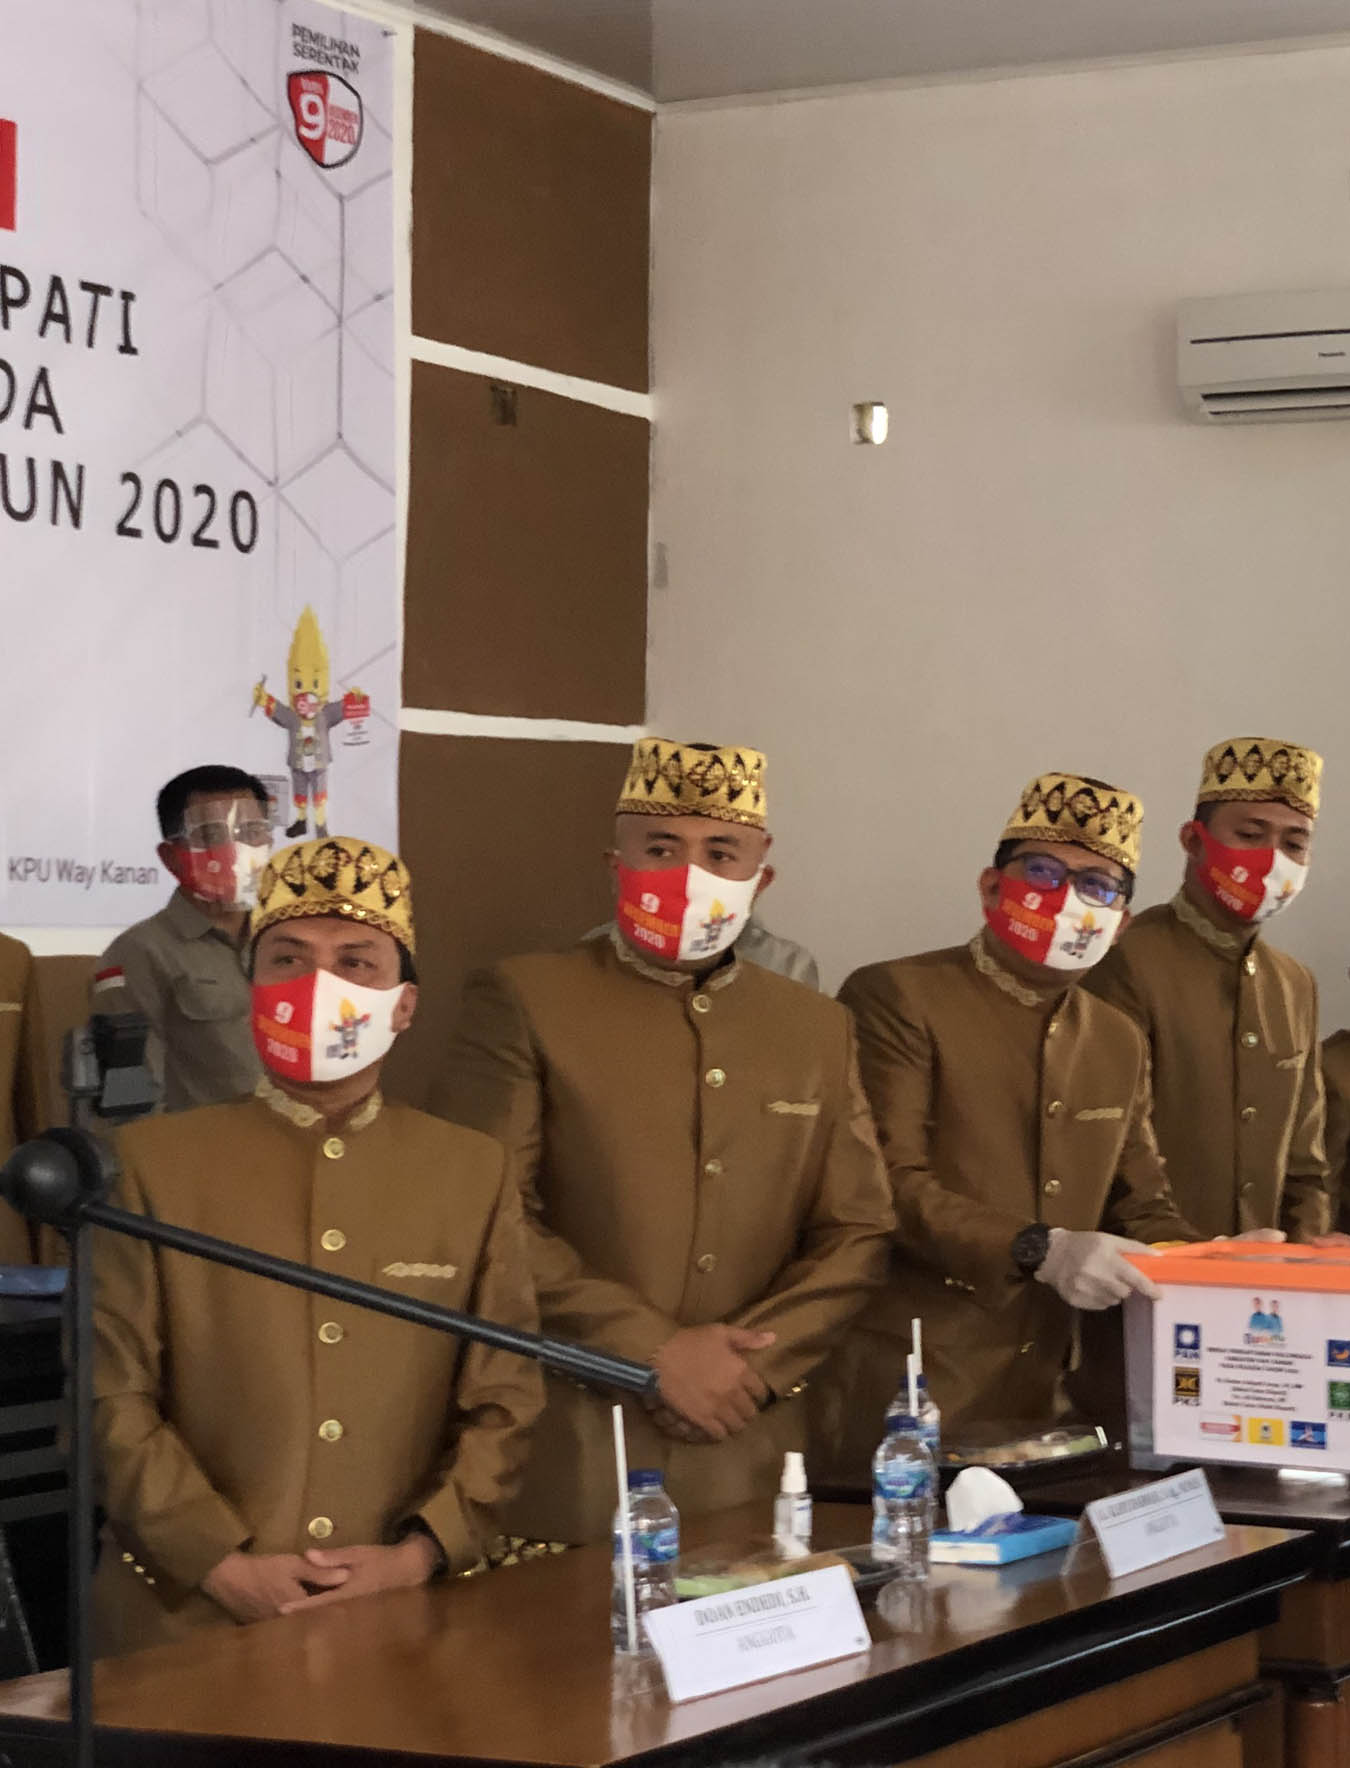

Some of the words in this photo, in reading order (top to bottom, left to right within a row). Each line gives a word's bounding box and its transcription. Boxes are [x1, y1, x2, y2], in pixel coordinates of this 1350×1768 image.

[299, 93, 326, 141] 9
[0, 264, 139, 355] PATI
[0, 453, 85, 529] UN
[116, 471, 258, 553] 2020
[8, 858, 49, 883] KPU
[56, 859, 96, 890] Way
[101, 862, 158, 885] Kanan
